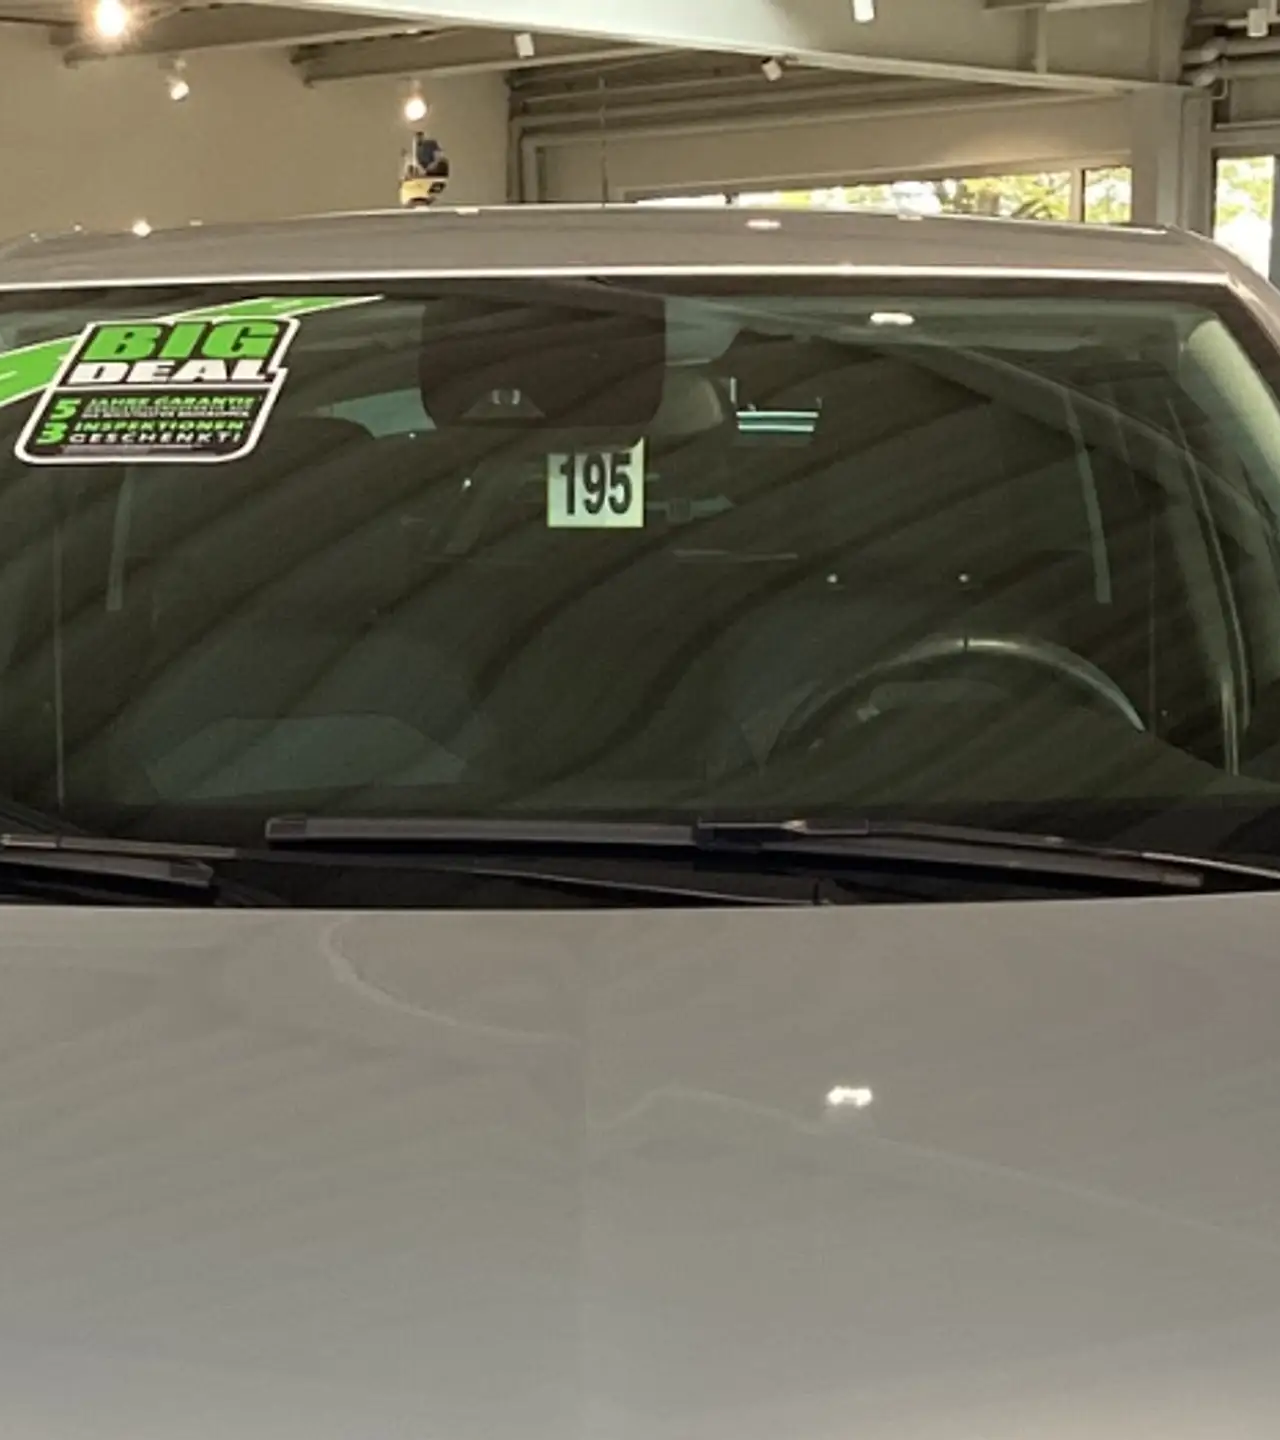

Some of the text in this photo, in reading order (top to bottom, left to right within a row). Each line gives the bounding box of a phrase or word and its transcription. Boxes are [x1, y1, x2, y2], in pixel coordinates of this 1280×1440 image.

[82, 320, 280, 360] BIG
[68, 359, 269, 384] DEAL
[50, 398, 81, 419] 5
[36, 421, 243, 444] 3 INSPEKTIONEN
[559, 452, 632, 515] 195
